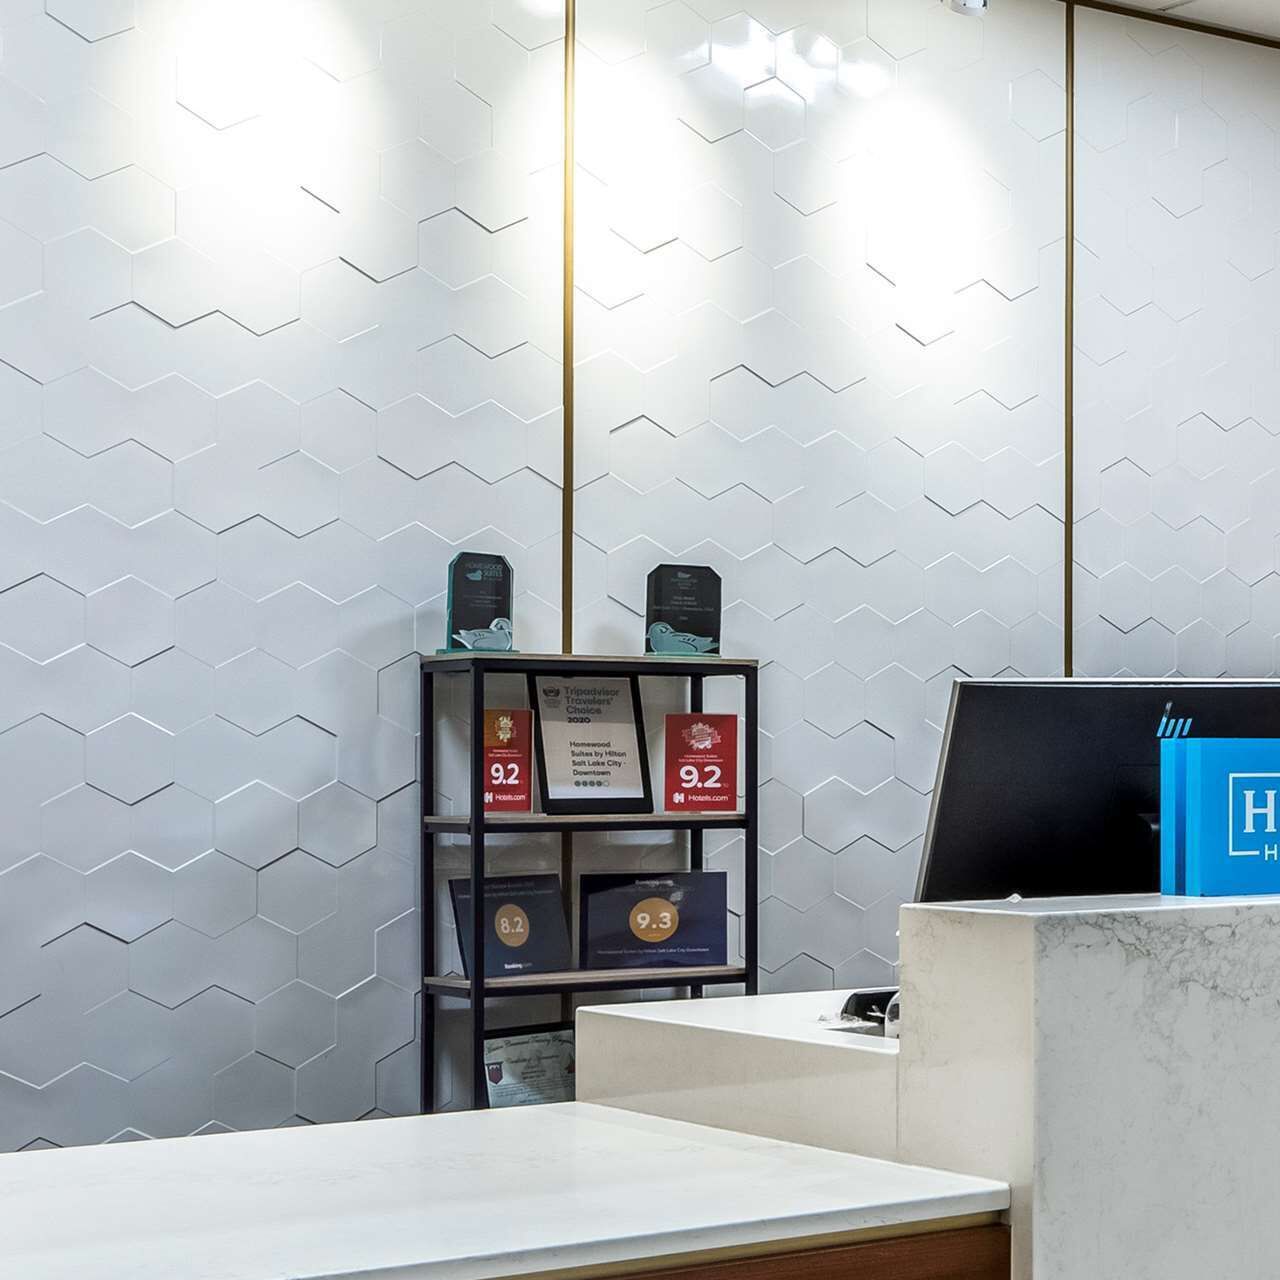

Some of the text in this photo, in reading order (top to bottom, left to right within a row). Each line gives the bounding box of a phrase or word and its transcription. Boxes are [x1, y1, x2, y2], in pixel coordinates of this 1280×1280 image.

[563, 686, 619, 697] Tripadvisor
[564, 696, 614, 705] Travelers'
[566, 705, 602, 715] Choice
[594, 750, 604, 758] by
[606, 760, 622, 768] City
[490, 762, 520, 785] 9.2
[679, 765, 722, 788] 9.2
[500, 916, 524, 934] 8.2
[636, 912, 672, 929] 9.3
